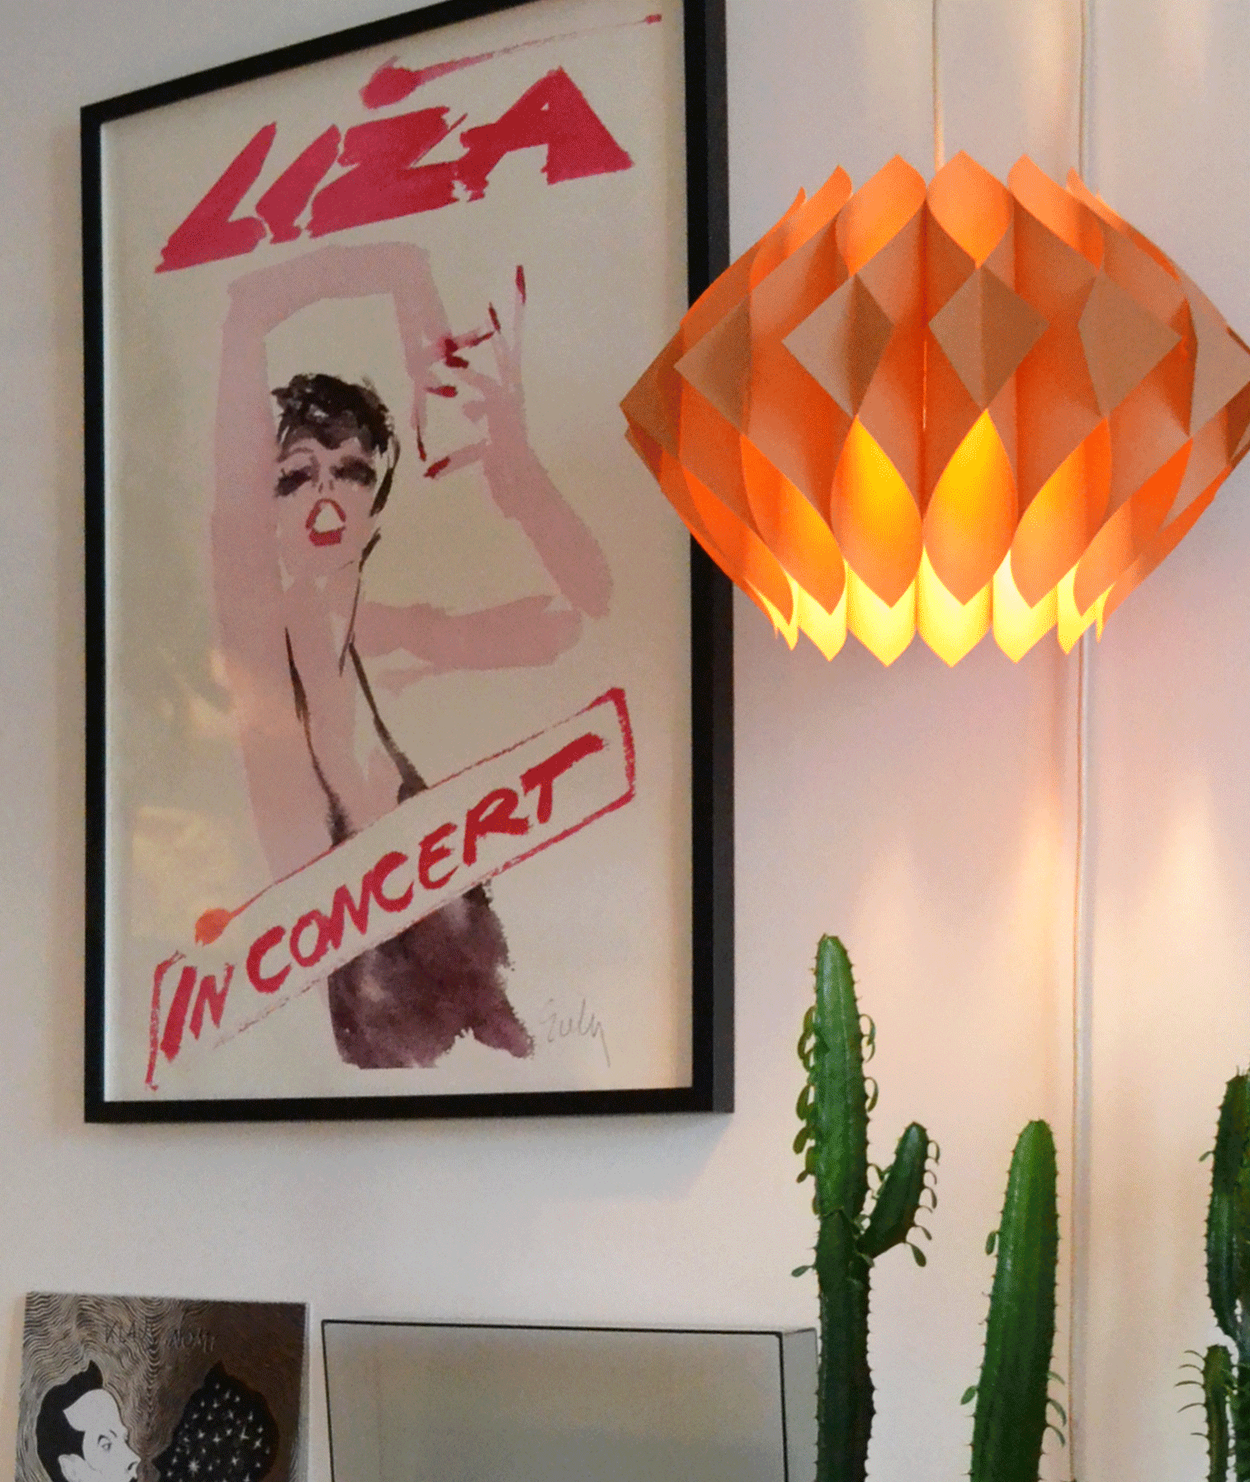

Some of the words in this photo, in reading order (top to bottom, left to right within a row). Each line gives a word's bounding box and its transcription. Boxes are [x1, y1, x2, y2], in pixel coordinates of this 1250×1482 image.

[154, 57, 636, 273] LIZA
[160, 961, 238, 1062] IN
[246, 731, 610, 993] CONCERT
